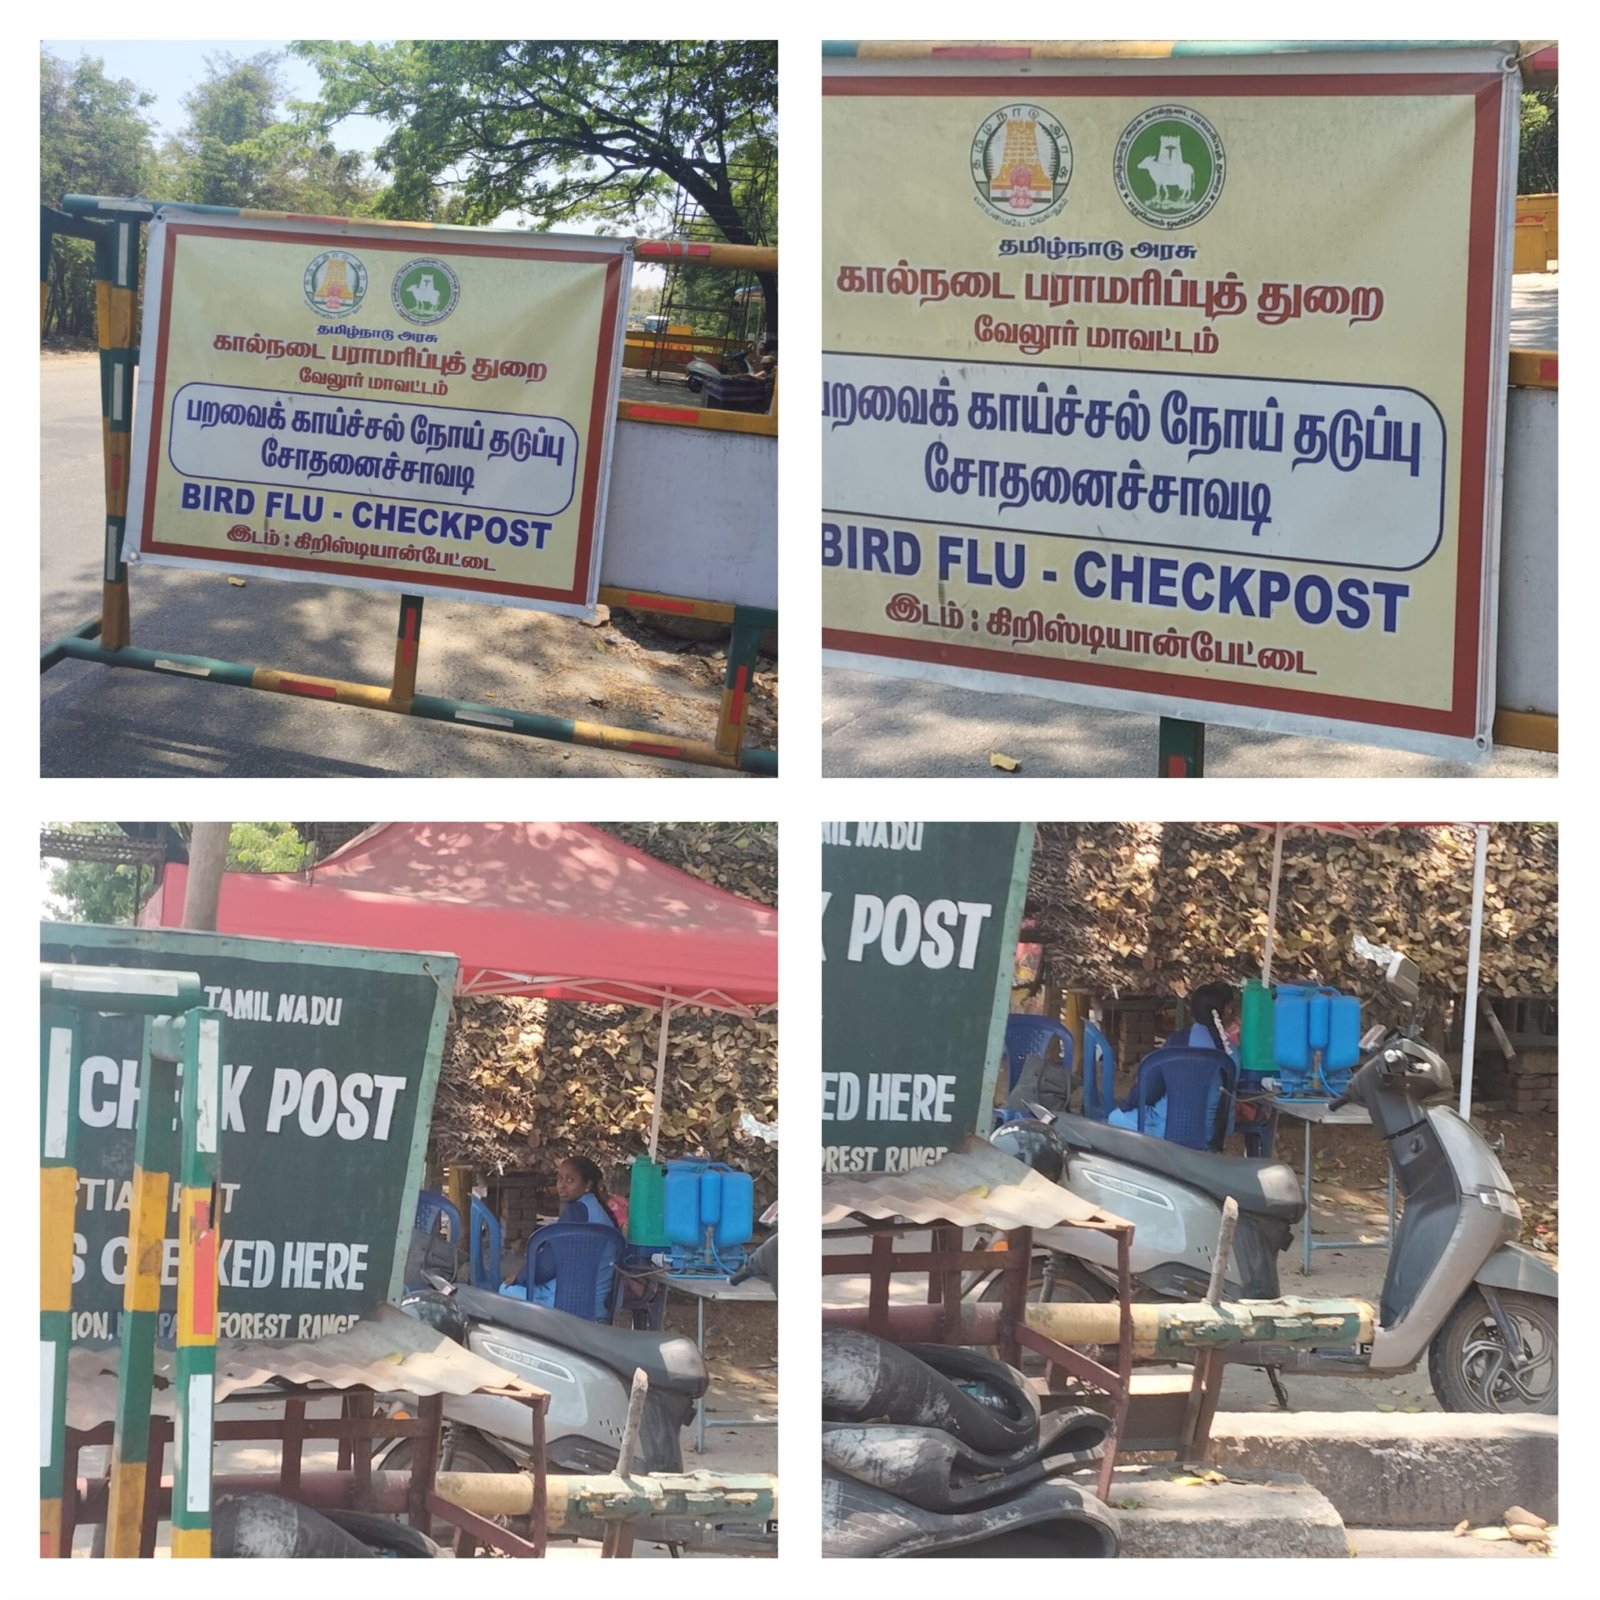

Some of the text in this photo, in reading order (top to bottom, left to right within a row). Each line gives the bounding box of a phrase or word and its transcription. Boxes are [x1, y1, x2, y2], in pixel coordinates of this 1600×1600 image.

[999, 236, 1198, 261] தமிழ்நாடு அரசு
[837, 259, 1384, 328] கால்நடை பராமரிப்புத் துறை
[213, 332, 548, 384] கால்நடை பராமரிப்புத் துறை
[316, 323, 439, 343] தமிழ்நாடு அரசு
[974, 313, 1219, 355] வேலூர் மாவட்டம்
[300, 366, 448, 396] வேலூர் மாவட்டம்
[186, 399, 564, 466] பறவைக் காய்ச்சல் நோய் தடுப்பு
[968, 381, 1150, 441] காய்ச்சல்
[1160, 389, 1284, 464] நோய்
[1292, 405, 1421, 477] தடுப்பு
[261, 437, 475, 495] சோதனைச்சாவடி
[924, 441, 1272, 536] சோதனைச்சாவடி
[181, 482, 255, 515] BIRD
[265, 491, 323, 523] FLU
[352, 501, 552, 550] CHECKPOST
[294, 533, 496, 571] கிறிஸ்டியான்பேட்டை
[822, 523, 921, 576] BIRD
[938, 536, 1025, 589] FLU
[1074, 550, 1409, 633] CHECKPOST
[986, 606, 1317, 675] கிறிஸ்டியான்பேட்டை
[855, 822, 924, 851] NADU
[847, 893, 992, 970] POST
[204, 985, 343, 1026] TAMIL NADU
[266, 1067, 407, 1141] POST
[867, 1072, 956, 1122] HERE
[281, 1241, 369, 1291] HERE
[217, 1312, 292, 1340] FOREST
